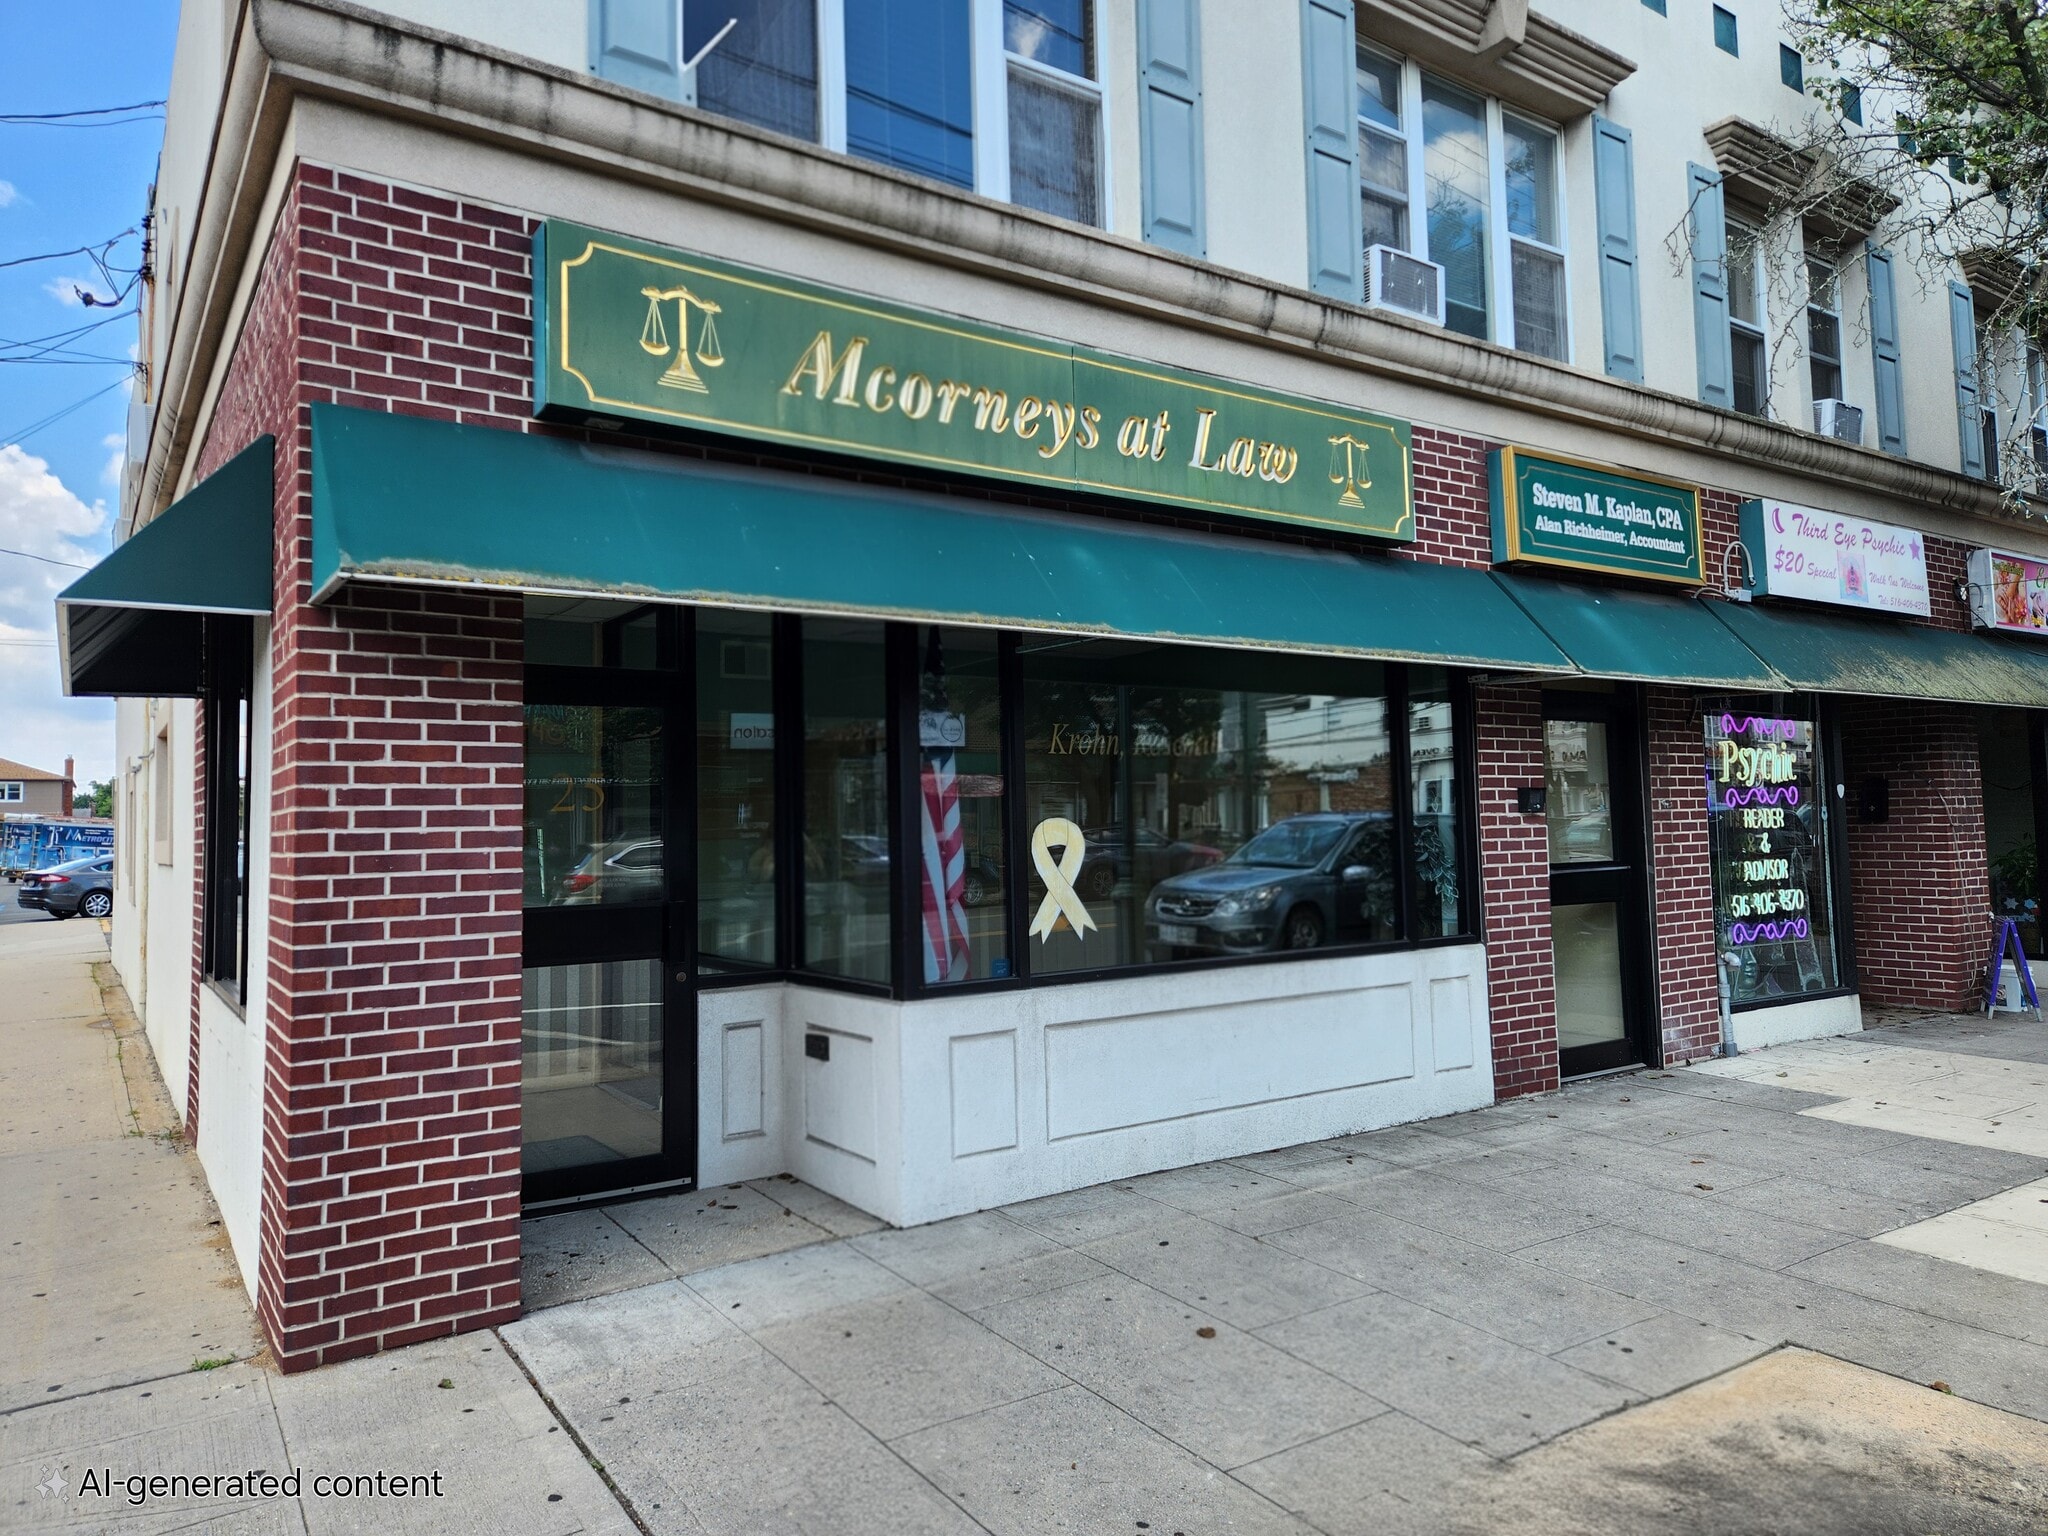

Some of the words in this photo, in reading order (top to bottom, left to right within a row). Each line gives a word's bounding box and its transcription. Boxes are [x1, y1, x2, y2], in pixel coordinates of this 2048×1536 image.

[1117, 410, 1171, 462] at
[1188, 407, 1298, 484] Law
[1532, 482, 1583, 513] Steven
[1585, 492, 1604, 516] M.
[1605, 496, 1656, 530] Kaplan,
[1656, 506, 1684, 531] CPA
[1535, 514, 1562, 534] Alan
[1563, 519, 1628, 546] Richheimer,
[1629, 531, 1685, 554] Accountant
[1792, 513, 1828, 541] Third
[1834, 522, 1857, 547] Eye
[1861, 528, 1906, 556] Psychic
[1773, 545, 1805, 574] $20
[1807, 563, 1837, 580] Special
[1869, 572, 1886, 584] Walk
[1900, 577, 1925, 591] Welcome
[1718, 740, 1798, 787] Psychic
[65, 828, 114, 843] METROCIT
[1743, 808, 1785, 829] READER
[1760, 832, 1772, 853] &
[1743, 859, 1789, 882] ADVISOR
